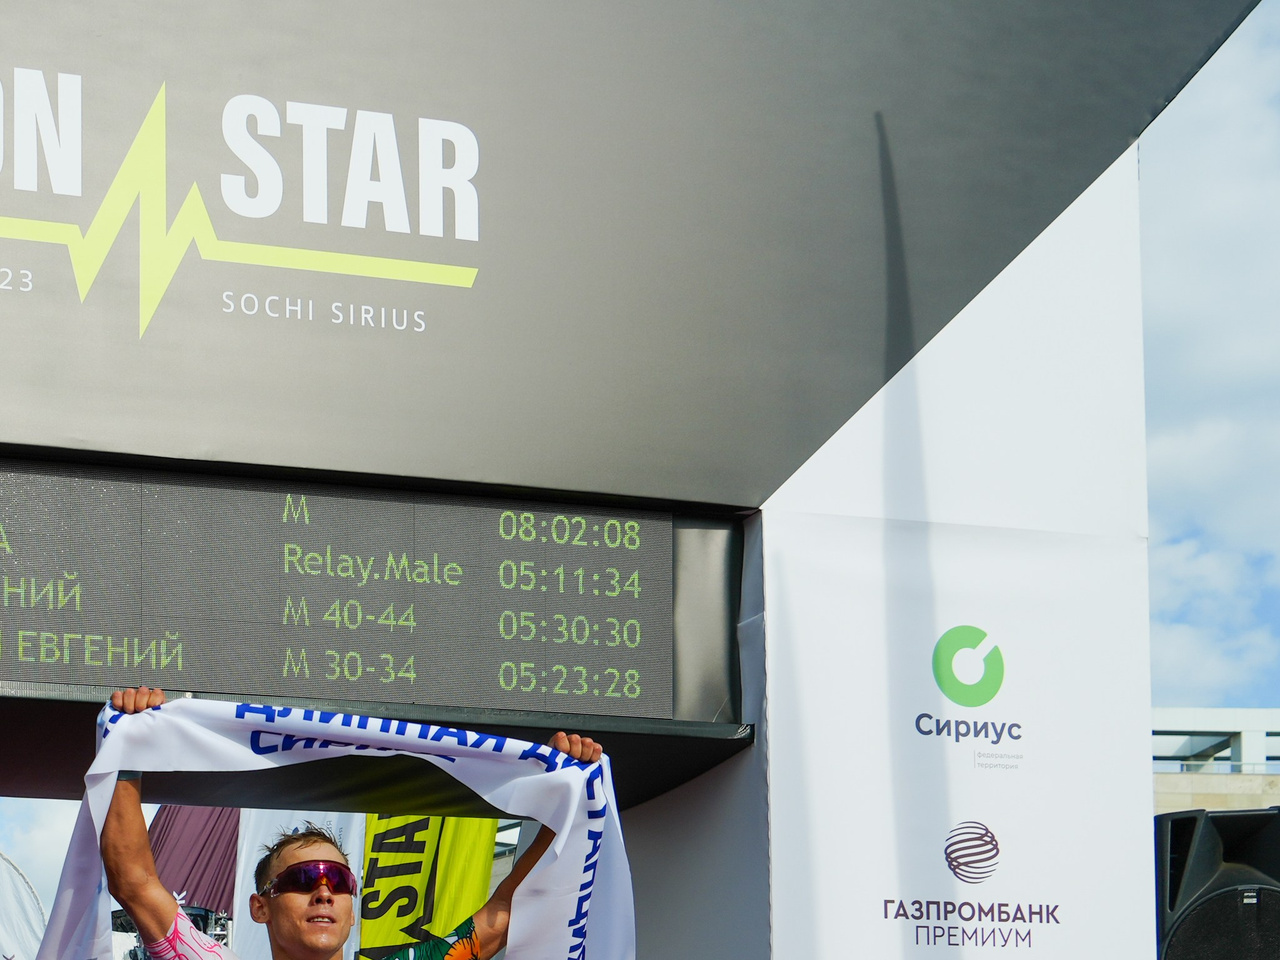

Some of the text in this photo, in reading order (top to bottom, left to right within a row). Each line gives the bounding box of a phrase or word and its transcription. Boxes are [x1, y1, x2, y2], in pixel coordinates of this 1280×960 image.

[220, 93, 480, 242] STAR
[220, 290, 428, 333] SOCHI SIRIUS
[498, 510, 642, 551] 08:02:08
[283, 543, 464, 588] Relay.Male
[498, 559, 642, 599] 05:11:34
[322, 600, 417, 634] 40-44
[498, 610, 642, 648] 05:30:30
[18, 629, 184, 672] ЕВГЕНИЙ
[324, 650, 417, 685] 30-34
[498, 661, 642, 699] 05:23:28
[914, 712, 1023, 746] Сириус
[361, 814, 431, 921] STA
[882, 899, 1061, 925] ГАЗПРОМБАНК
[915, 925, 1032, 948] ПРЕМИУМ
